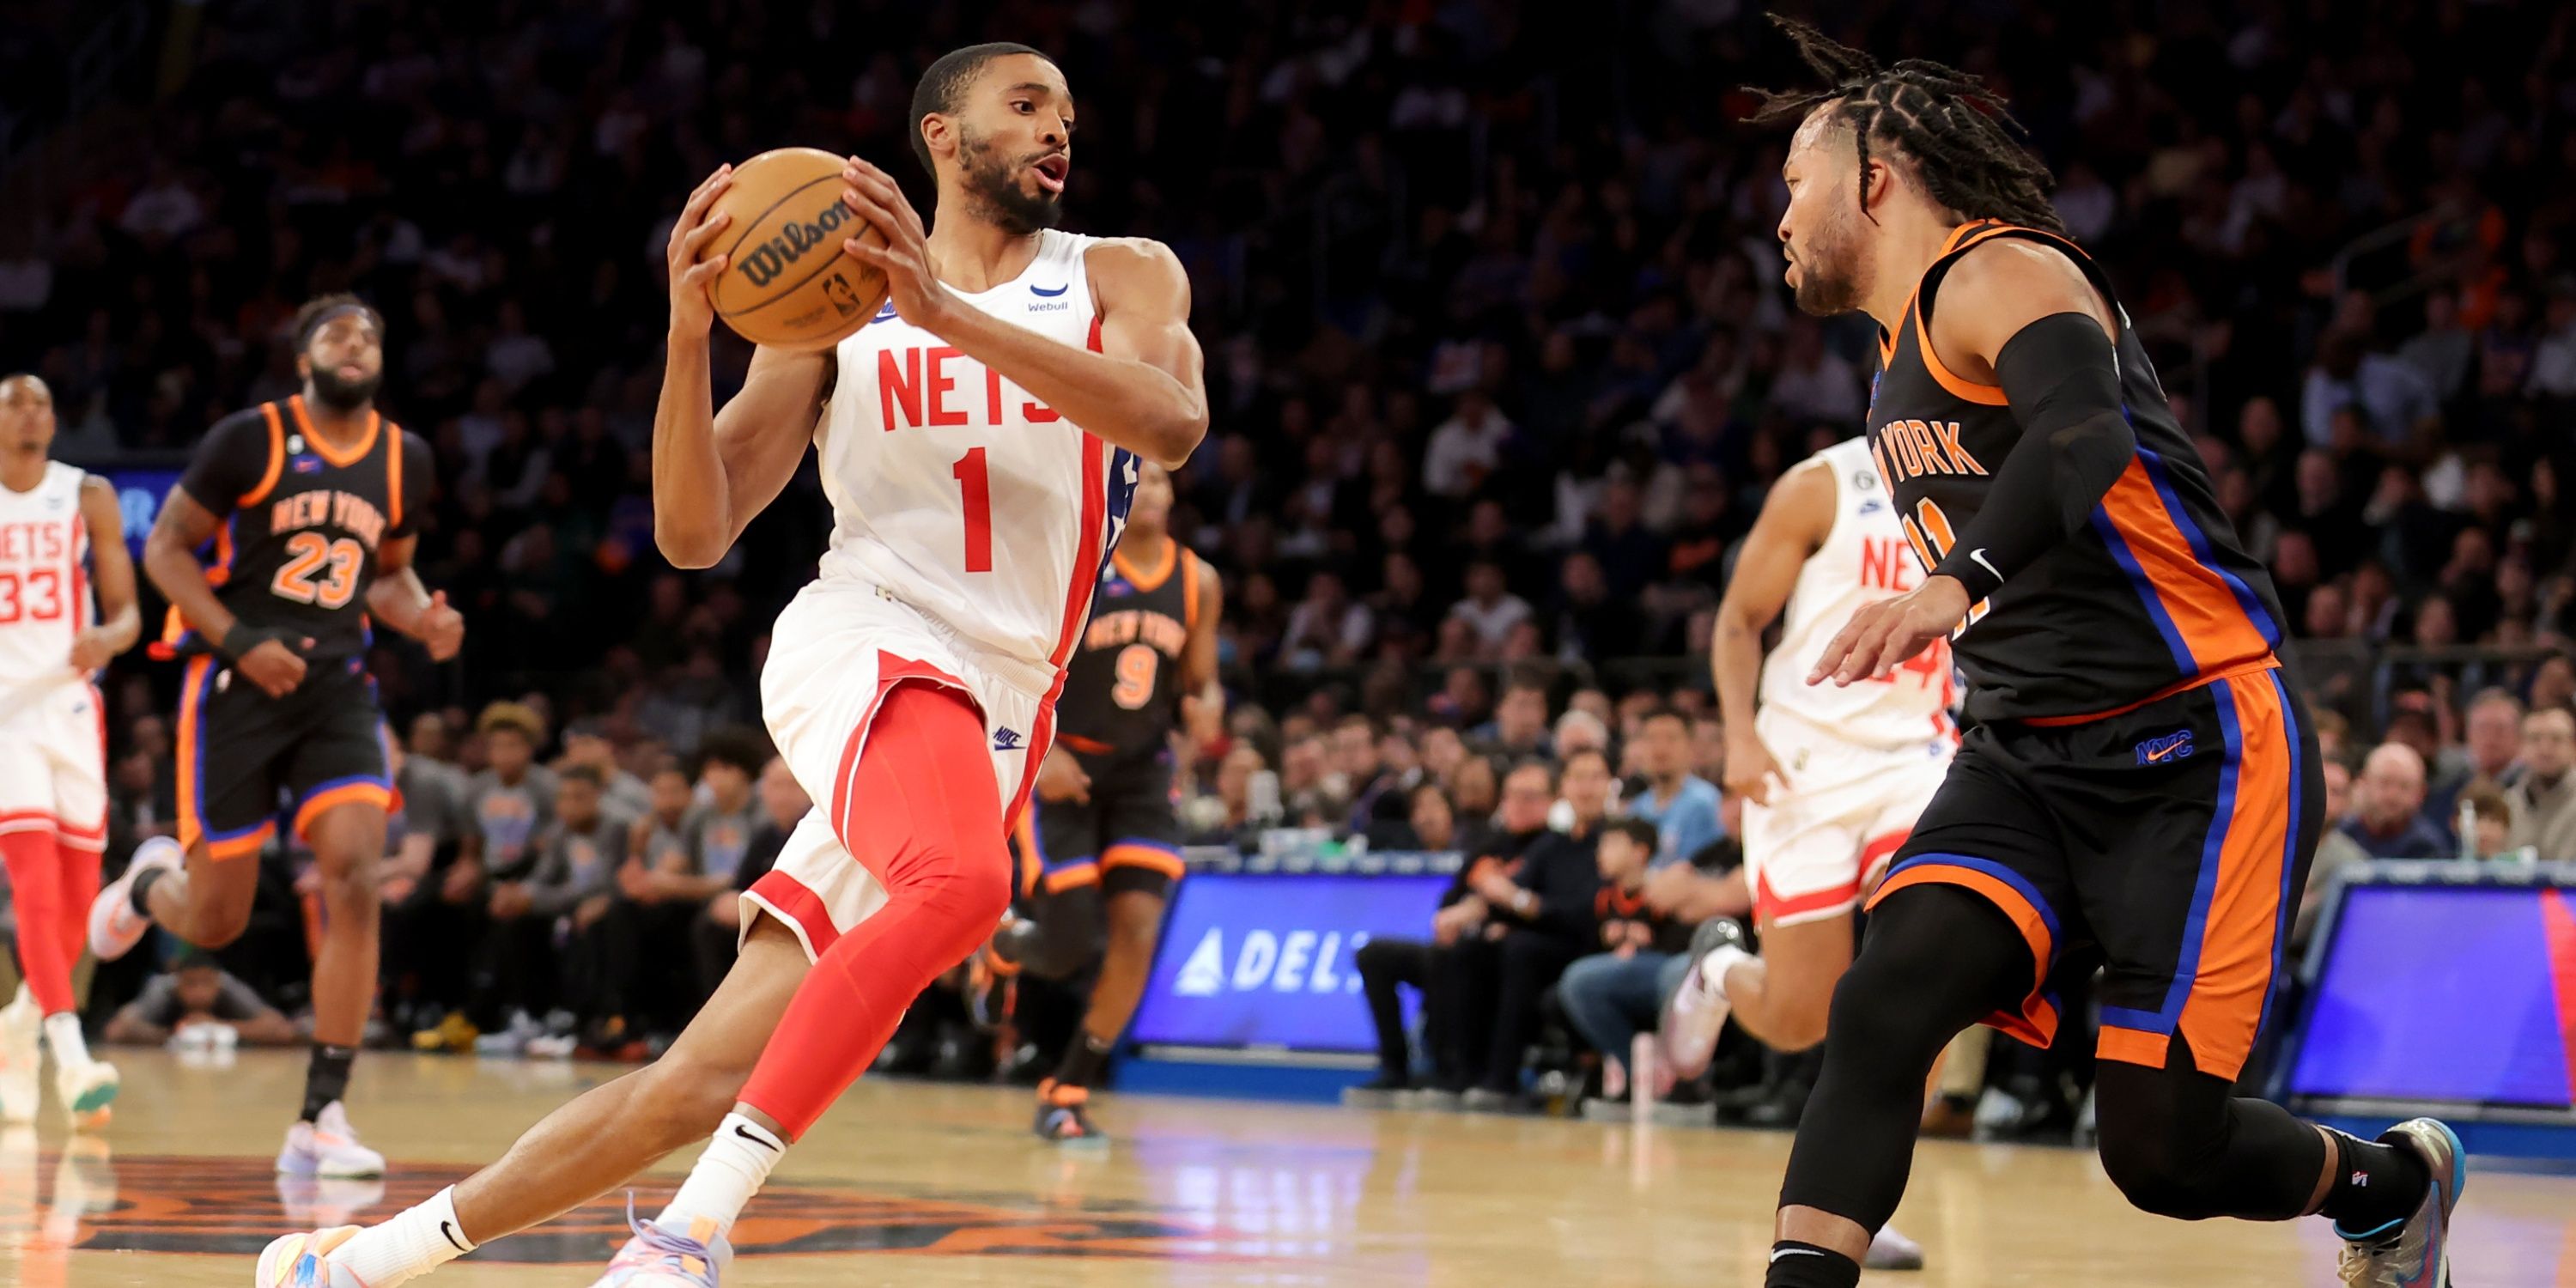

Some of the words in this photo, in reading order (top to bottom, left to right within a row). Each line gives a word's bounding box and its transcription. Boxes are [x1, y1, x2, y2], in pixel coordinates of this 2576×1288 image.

[737, 197, 851, 288] Wilson
[1028, 301, 1068, 312] Webull
[878, 345, 1061, 432] NET
[1880, 419, 1990, 483] YORK
[0, 520, 62, 560] ETS
[271, 489, 331, 537] NEW
[331, 489, 386, 552] YORK
[952, 446, 993, 573] 1
[0, 568, 63, 622] 33
[271, 531, 364, 610] 23
[1111, 643, 1158, 710] 9
[992, 725, 1022, 746] NIKE
[2135, 729, 2194, 766] NYC
